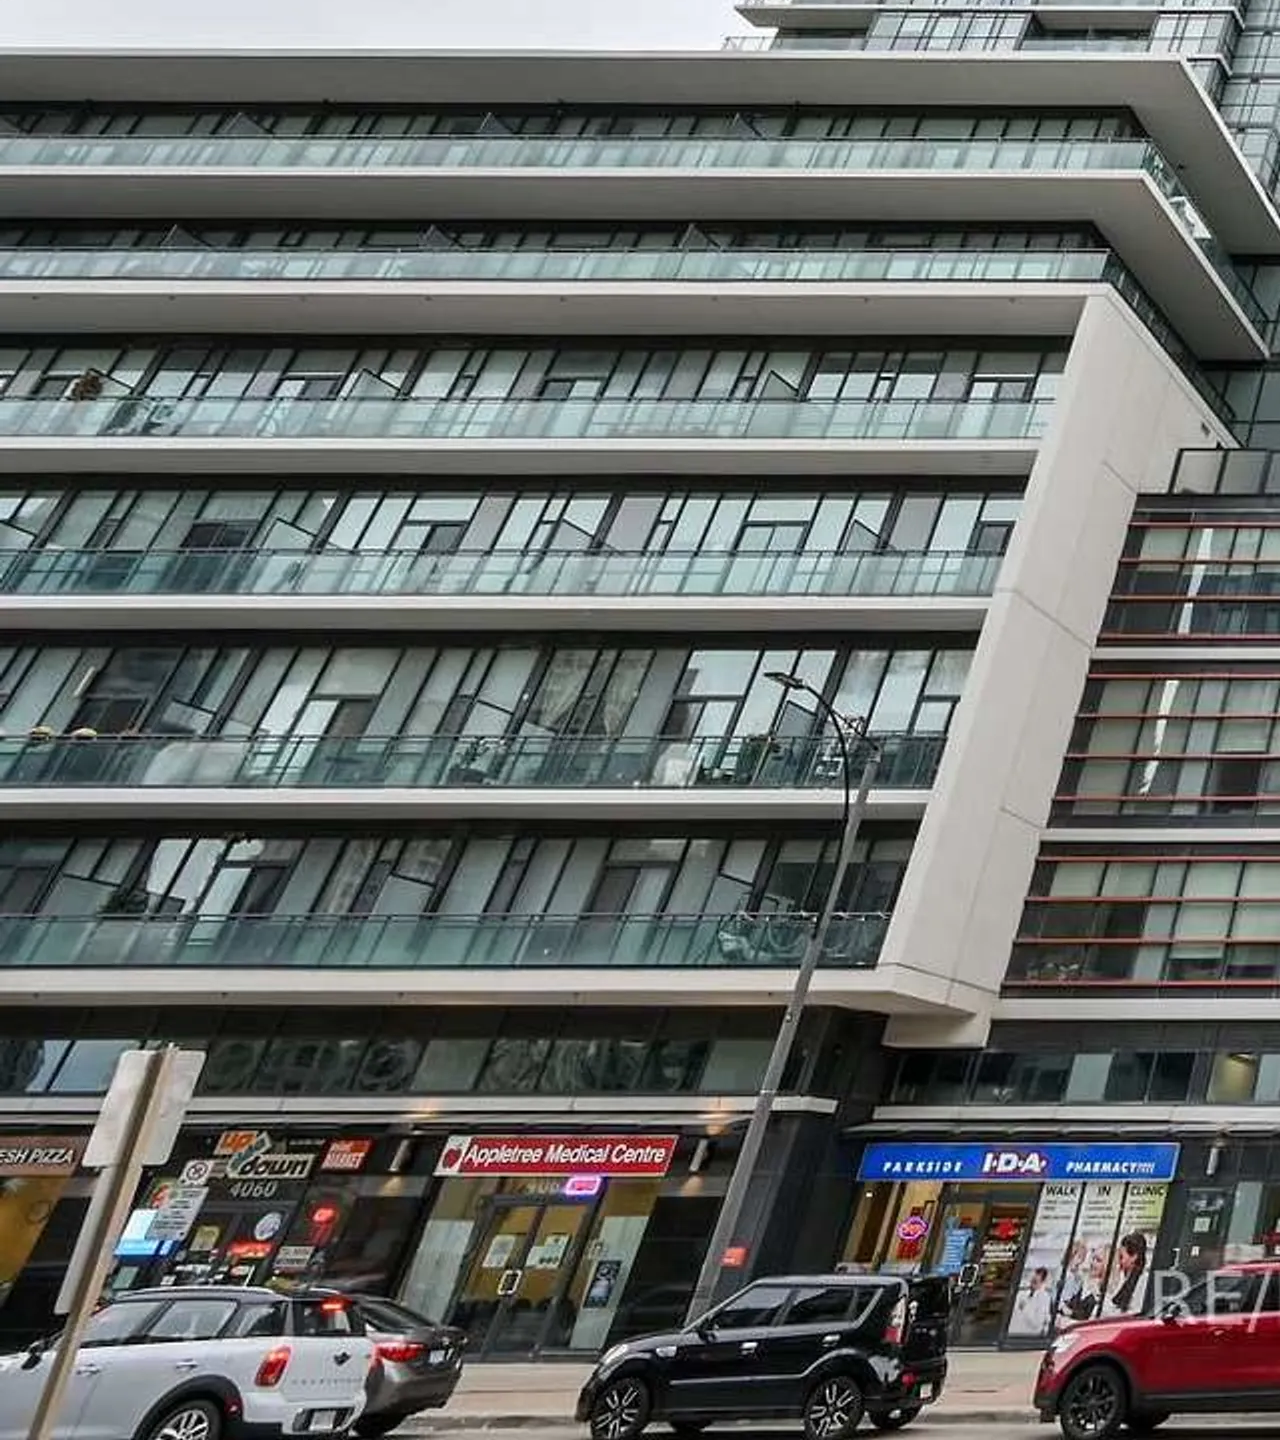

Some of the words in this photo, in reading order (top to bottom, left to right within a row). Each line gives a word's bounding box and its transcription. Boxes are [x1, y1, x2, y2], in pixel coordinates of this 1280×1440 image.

[28, 1147, 74, 1164] PIZZA
[466, 1144, 543, 1168] Appletree
[545, 1142, 609, 1163] Medical
[611, 1144, 666, 1163] Centre
[883, 1161, 963, 1173] PARKSIDE
[1066, 1162, 1137, 1174] PHARMACY
[230, 1180, 278, 1198] 4060
[1046, 1185, 1078, 1197] WALK
[1099, 1185, 1112, 1197] IN
[1130, 1185, 1166, 1197] CLINIC
